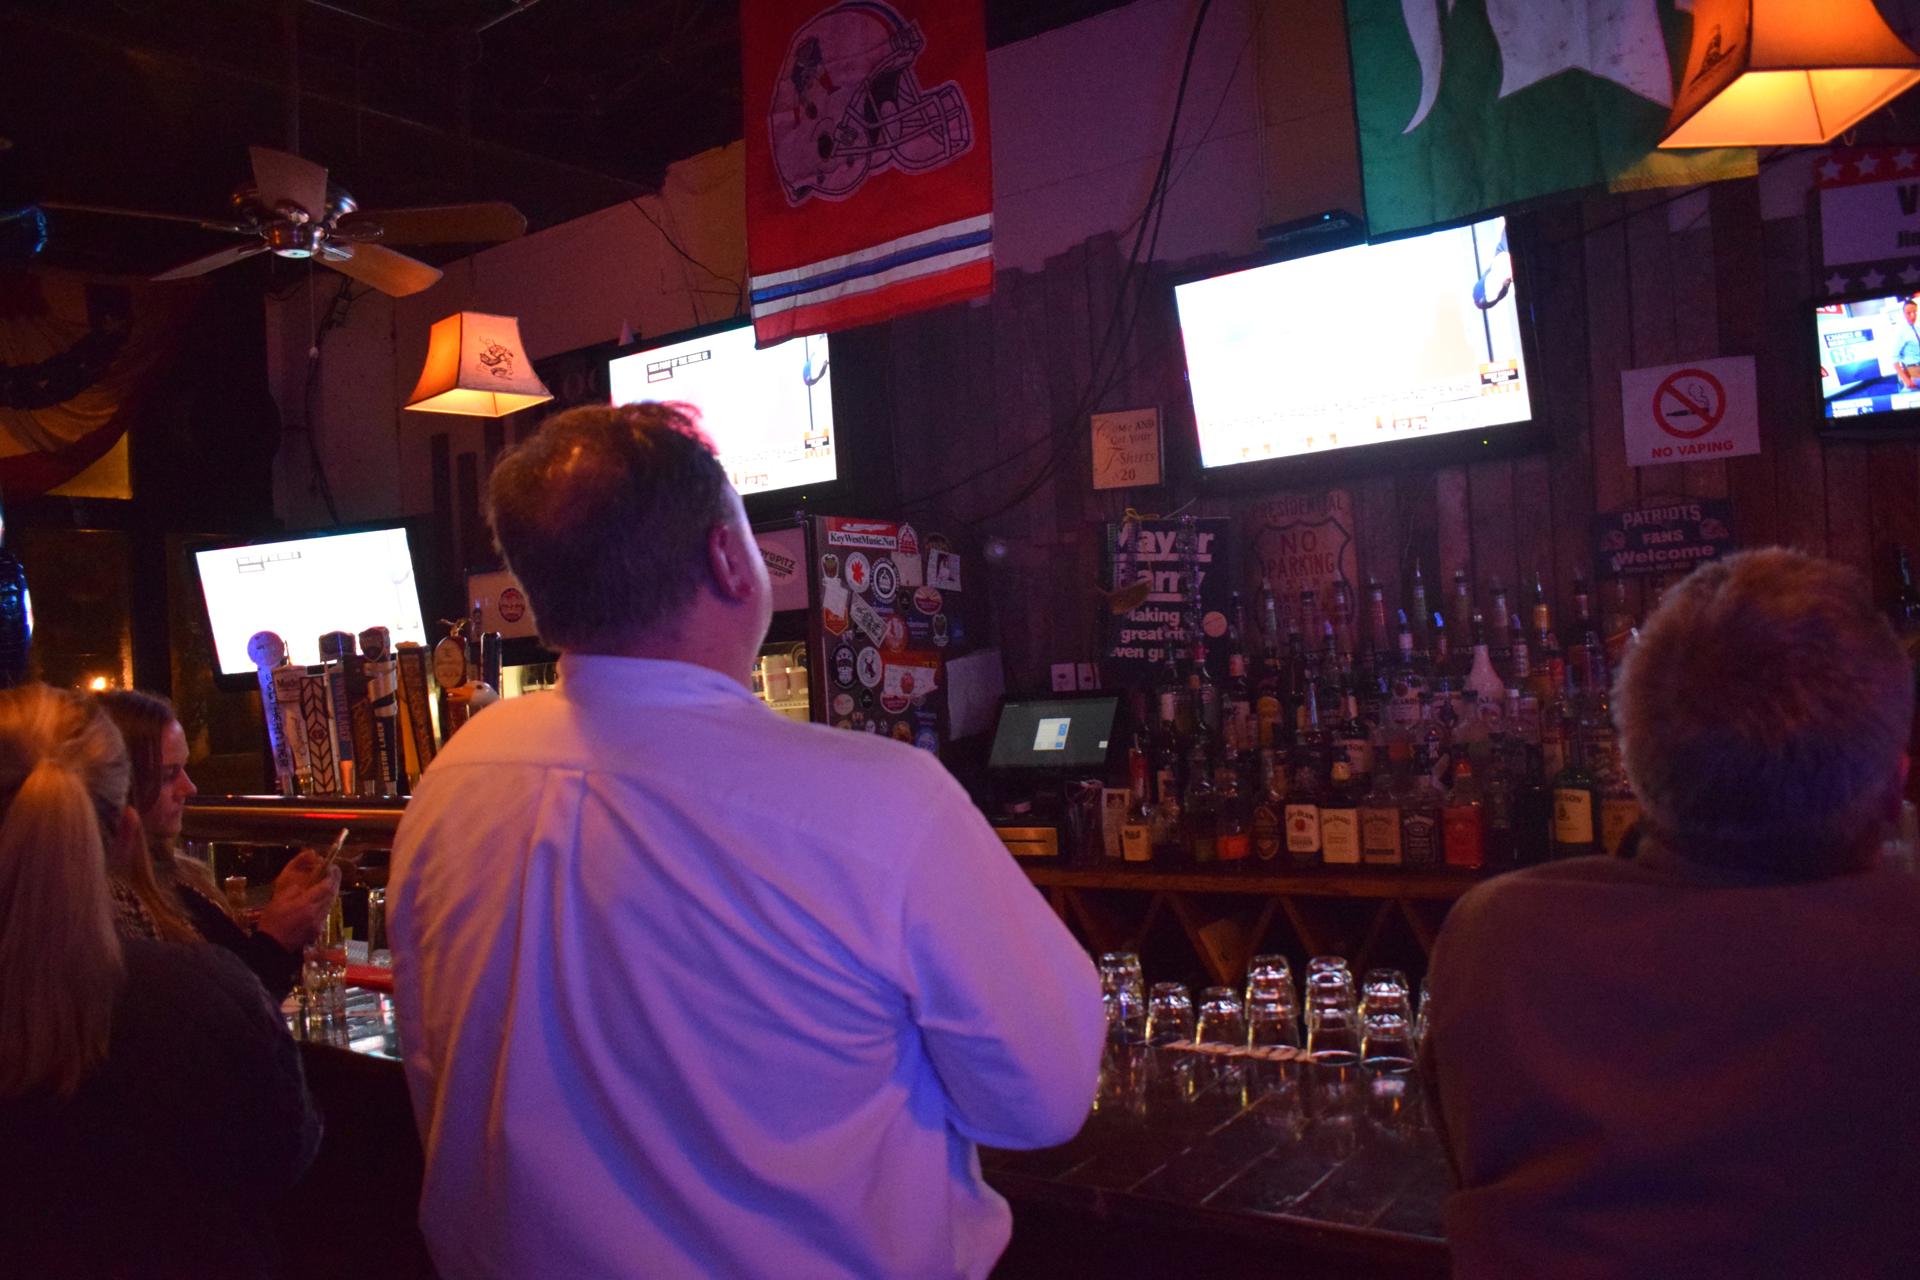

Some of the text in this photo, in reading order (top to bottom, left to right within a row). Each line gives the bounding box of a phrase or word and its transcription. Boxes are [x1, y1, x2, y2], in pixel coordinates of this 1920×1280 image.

[1652, 440, 1734, 459] NO VAPING
[1622, 504, 1702, 530] PATRIOTS
[830, 533, 896, 547] KeyWestMusic.Net
[1280, 529, 1318, 555] NO
[1641, 529, 1685, 545] FANS
[1267, 552, 1335, 579] PARKING
[1615, 544, 1716, 566] Welcome
[1113, 562, 1206, 597] arr
[1120, 626, 1163, 643] great
[376, 721, 386, 748] LAGER
